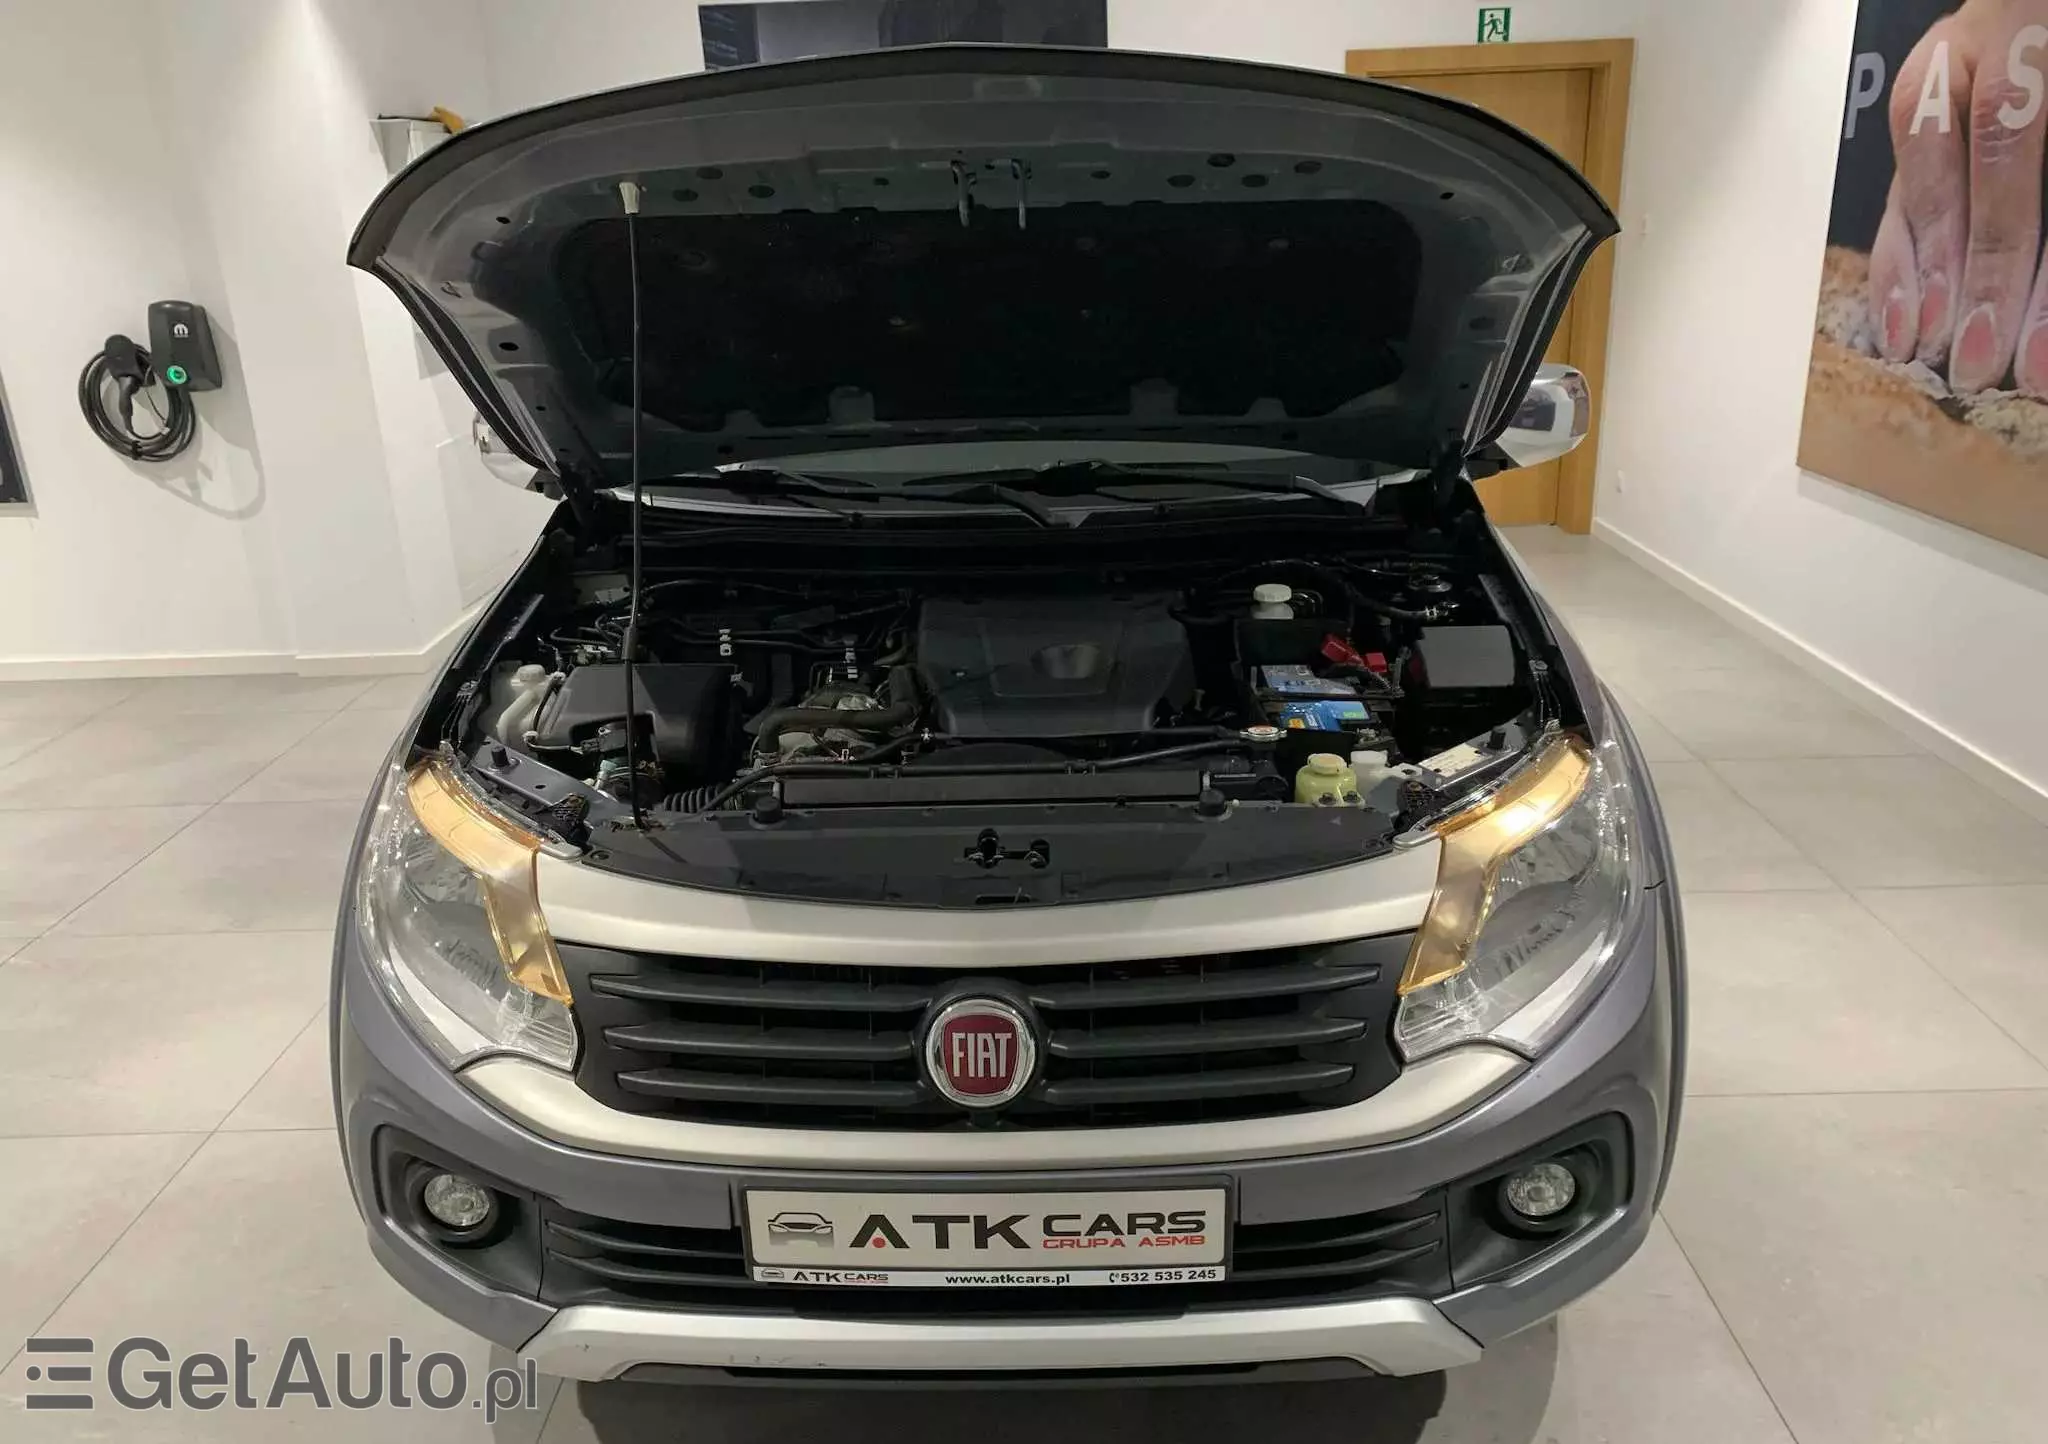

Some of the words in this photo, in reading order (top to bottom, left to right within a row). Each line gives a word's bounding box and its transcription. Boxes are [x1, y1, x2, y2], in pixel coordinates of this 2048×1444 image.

[952, 1032, 1012, 1078] FIAT
[849, 1214, 1030, 1249] ATK
[1043, 1210, 1206, 1236] CARS
[1042, 1238, 1126, 1249] GRUPA
[1138, 1235, 1206, 1246] ASMB
[792, 1271, 841, 1283] ATK
[844, 1273, 889, 1281] CARS
[945, 1273, 1070, 1286] www.atkcars.pl
[1120, 1272, 1149, 1283] 532
[1155, 1271, 1183, 1281] 535
[1187, 1269, 1217, 1280] 245
